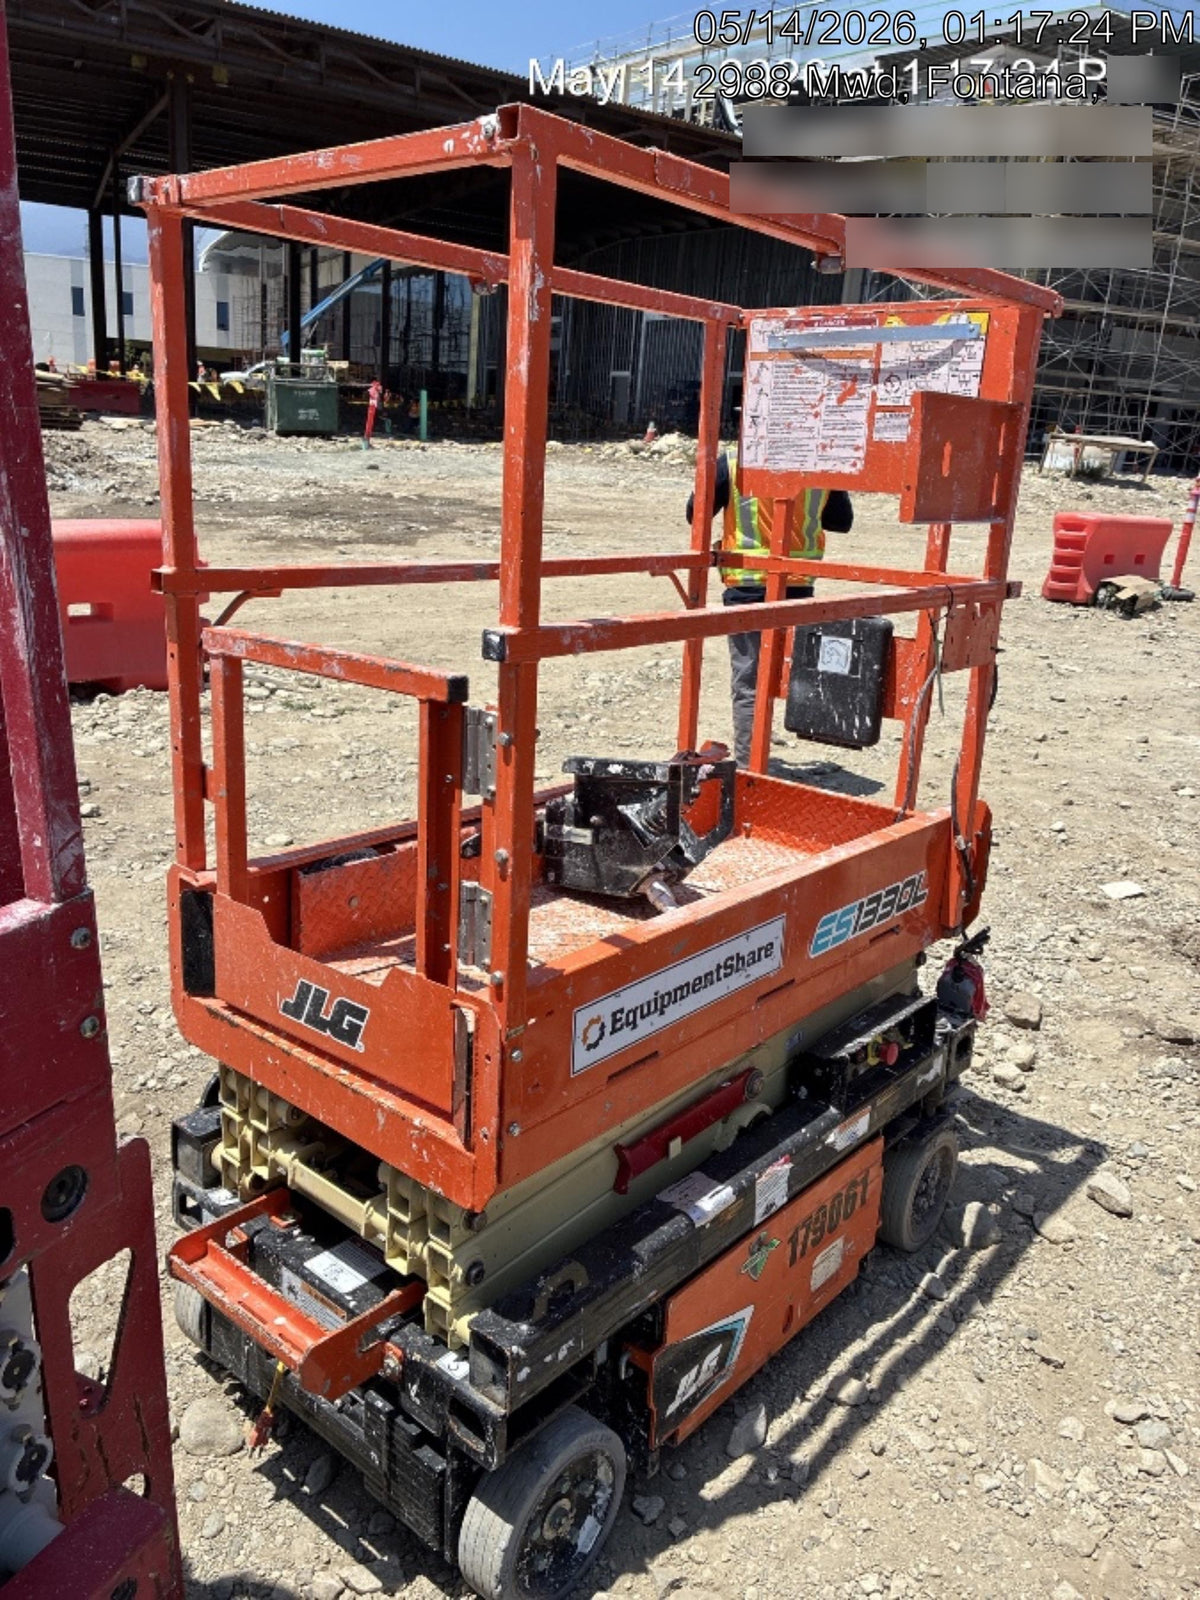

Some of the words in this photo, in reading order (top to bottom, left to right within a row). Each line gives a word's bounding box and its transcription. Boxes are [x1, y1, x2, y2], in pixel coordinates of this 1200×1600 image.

[810, 870, 928, 957] ES1330L
[279, 978, 370, 1050] JLG
[608, 940, 775, 1037] EquipmentShare
